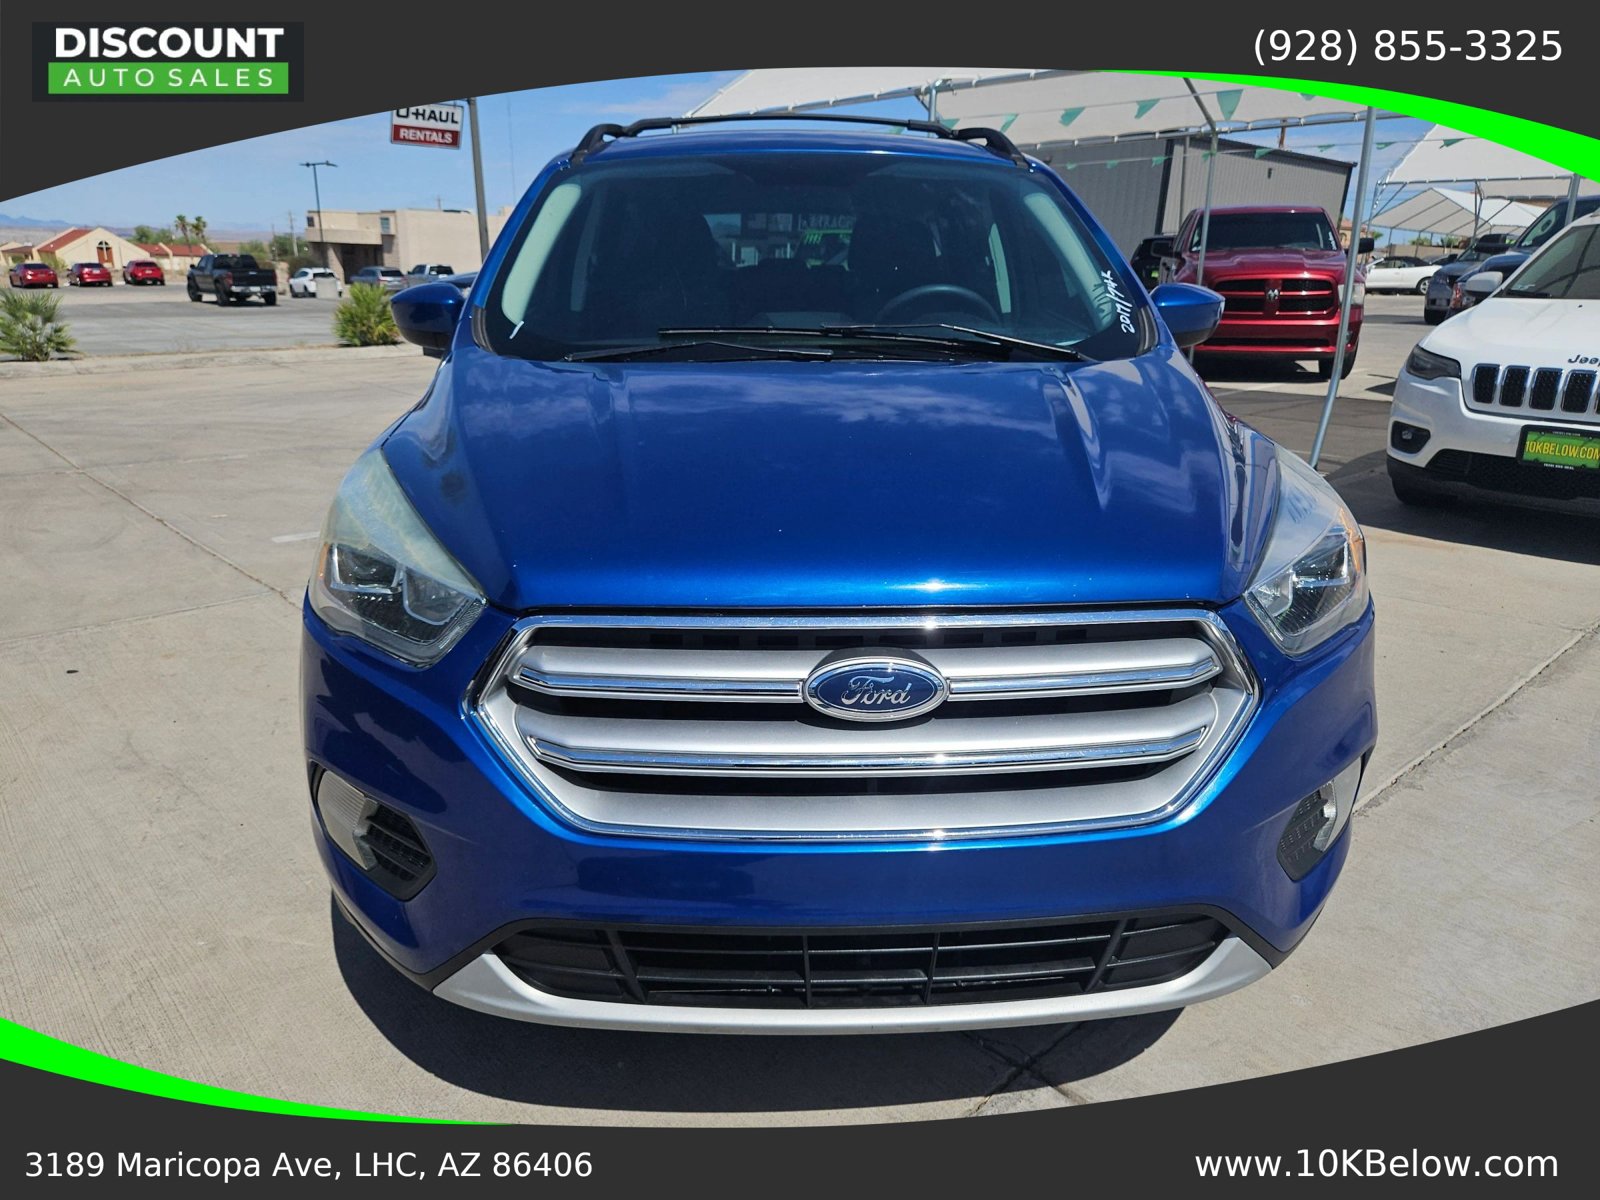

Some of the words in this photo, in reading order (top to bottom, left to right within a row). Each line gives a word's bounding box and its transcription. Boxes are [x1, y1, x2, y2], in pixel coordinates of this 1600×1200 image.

[396, 107, 459, 124] U-HAUL
[400, 127, 453, 144] RENTALS
[1568, 354, 1600, 367] Jee
[841, 675, 912, 705] Ford
